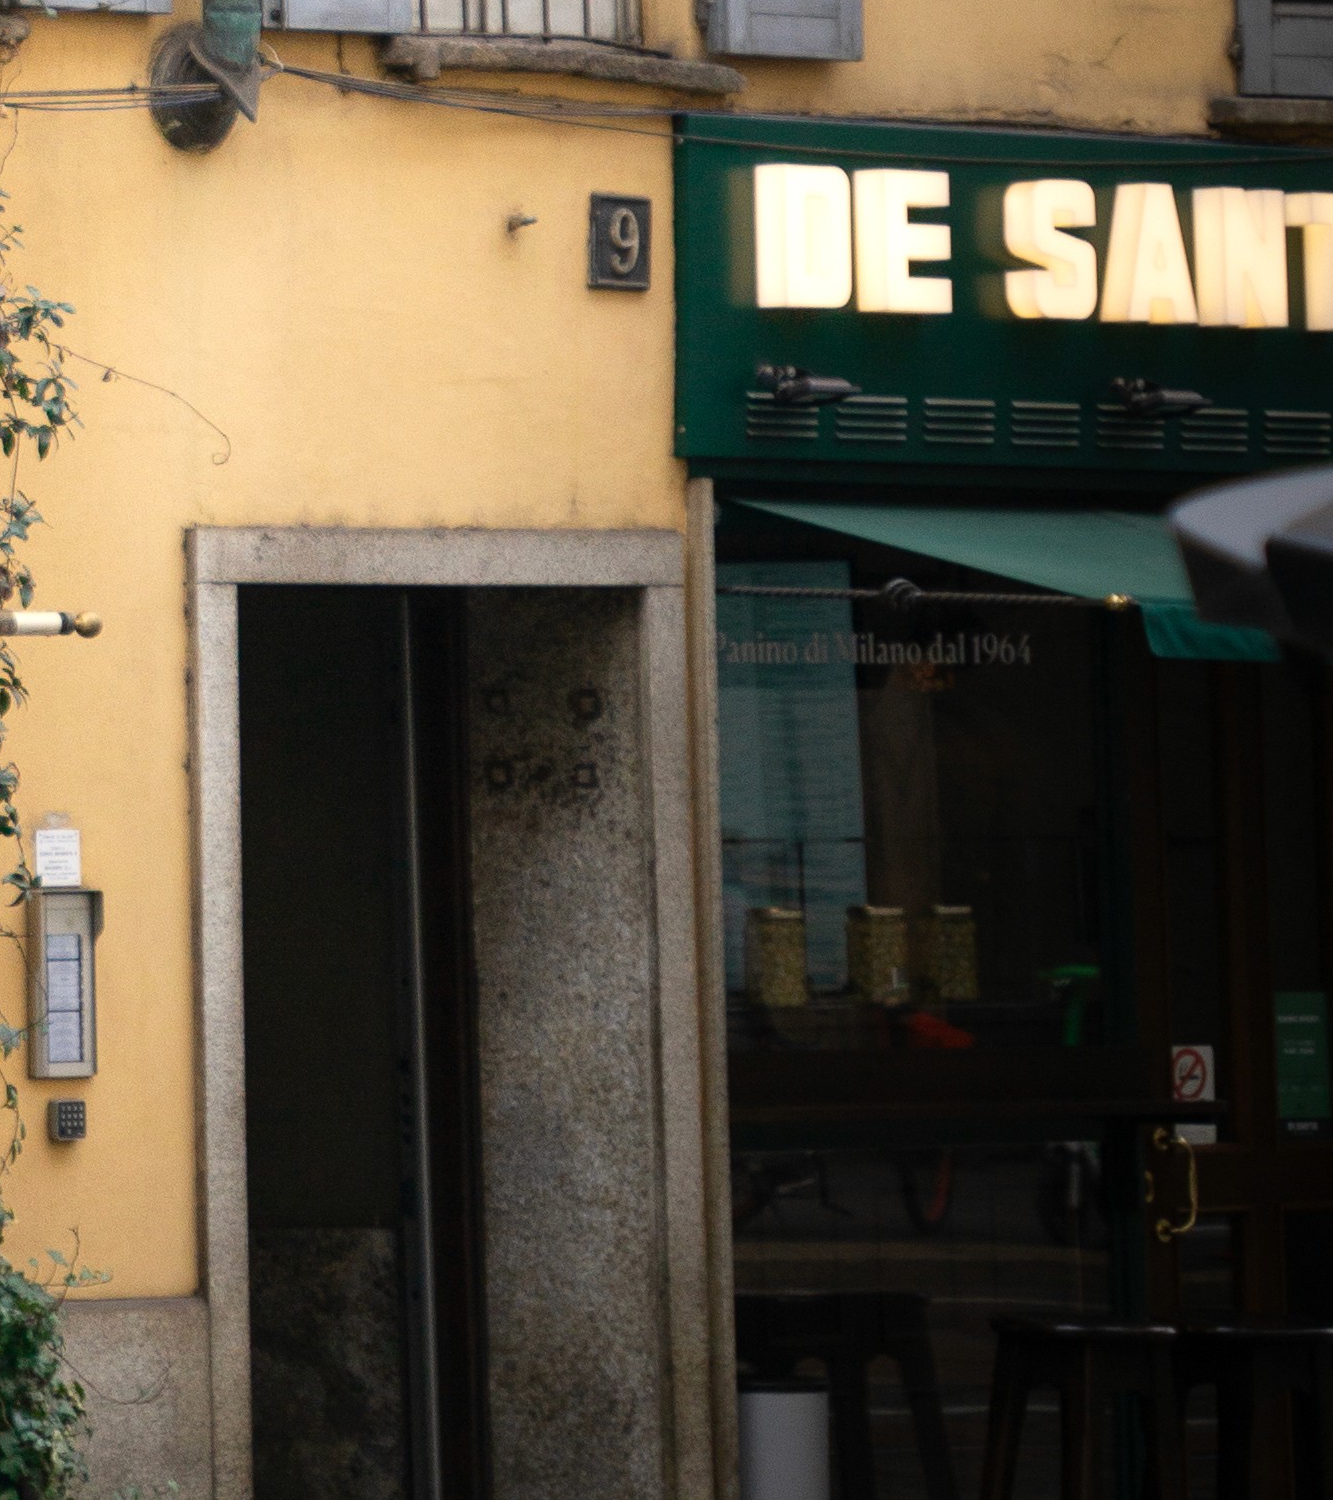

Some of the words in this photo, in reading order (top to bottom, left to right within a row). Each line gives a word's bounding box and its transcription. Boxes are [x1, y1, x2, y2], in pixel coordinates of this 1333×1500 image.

[609, 205, 642, 276] 9
[753, 162, 953, 315] DE
[804, 632, 829, 665] di
[832, 632, 922, 665] Milano
[927, 632, 967, 666] dal
[971, 633, 1032, 666] 1964
